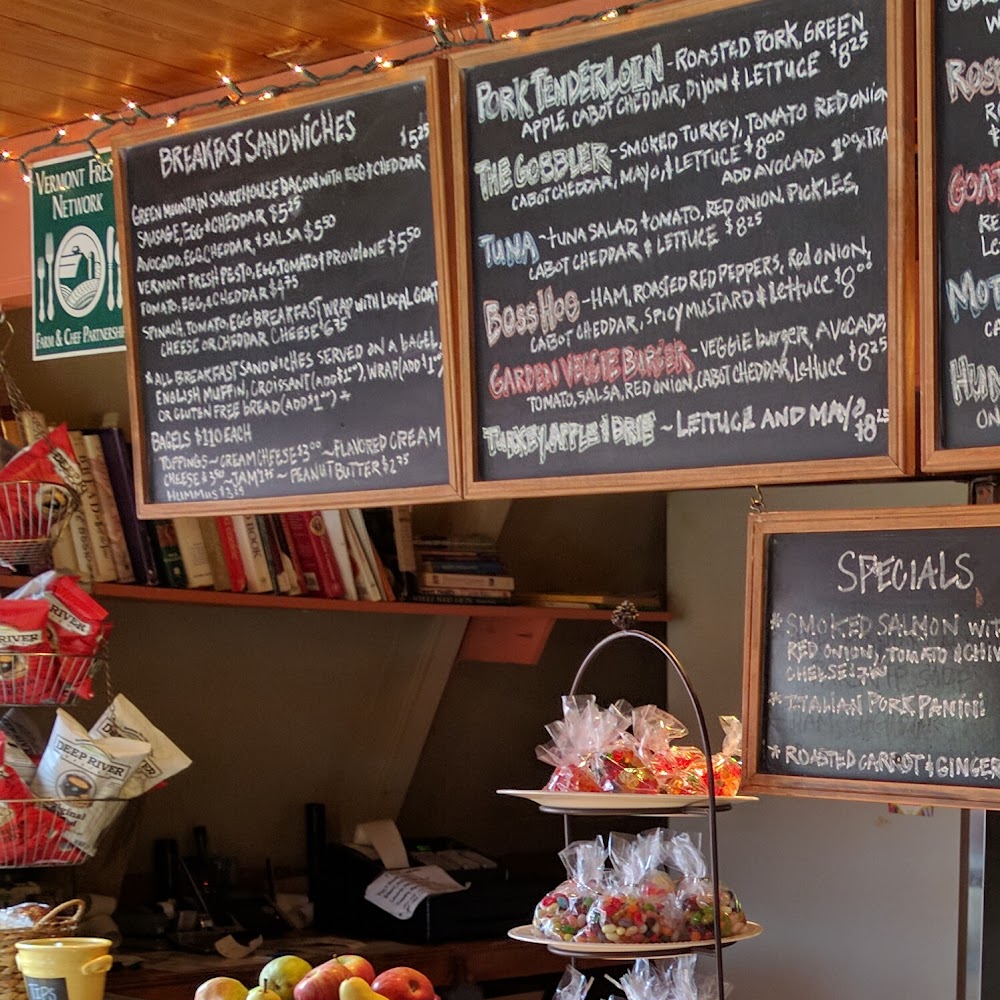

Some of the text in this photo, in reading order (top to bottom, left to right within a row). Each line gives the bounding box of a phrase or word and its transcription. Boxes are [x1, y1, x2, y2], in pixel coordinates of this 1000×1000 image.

[476, 77, 533, 123] PORK
[675, 37, 751, 72] ROASTED
[804, 11, 864, 42] GREEN
[573, 50, 820, 128] CABOT LETTUCE
[159, 110, 356, 179] BREAKFAST SANDWICHES
[474, 157, 512, 201] THE
[514, 142, 612, 188] GOBBLER
[620, 132, 678, 160] SMOKED
[512, 145, 741, 211] CABOT LETTUCE
[754, 147, 825, 180] AVOCADO
[35, 168, 85, 196] VERMONT
[132, 198, 161, 227] GREEN
[374, 154, 426, 177] CHEDDAR
[52, 193, 103, 220] NETWORK
[478, 200, 733, 268] TUNA RED
[529, 224, 719, 280] CABOT CHEDDAR LETTUCE
[138, 266, 219, 295] VERMONT FRESH
[690, 267, 716, 291] RED
[252, 297, 322, 327] BREAKFAST
[531, 289, 754, 353] CABOT MUSTARD
[64, 328, 81, 345] CHEF
[160, 339, 200, 357] CHEESE
[271, 323, 319, 344] CHEESE
[175, 345, 363, 384] BREAKFAST SANDWICHES SERVED
[488, 358, 559, 399] GARDEN
[212, 401, 240, 419] FREE
[676, 405, 806, 437] LETTUCE AND
[151, 423, 252, 452] BAGELS EACH
[389, 426, 441, 449] CREAM
[838, 550, 974, 594] SPECIALS
[49, 605, 86, 632] RIVER
[868, 691, 917, 716] PORK
[56, 741, 125, 777] DEEP RIVER
[786, 745, 856, 769] ROASTED
